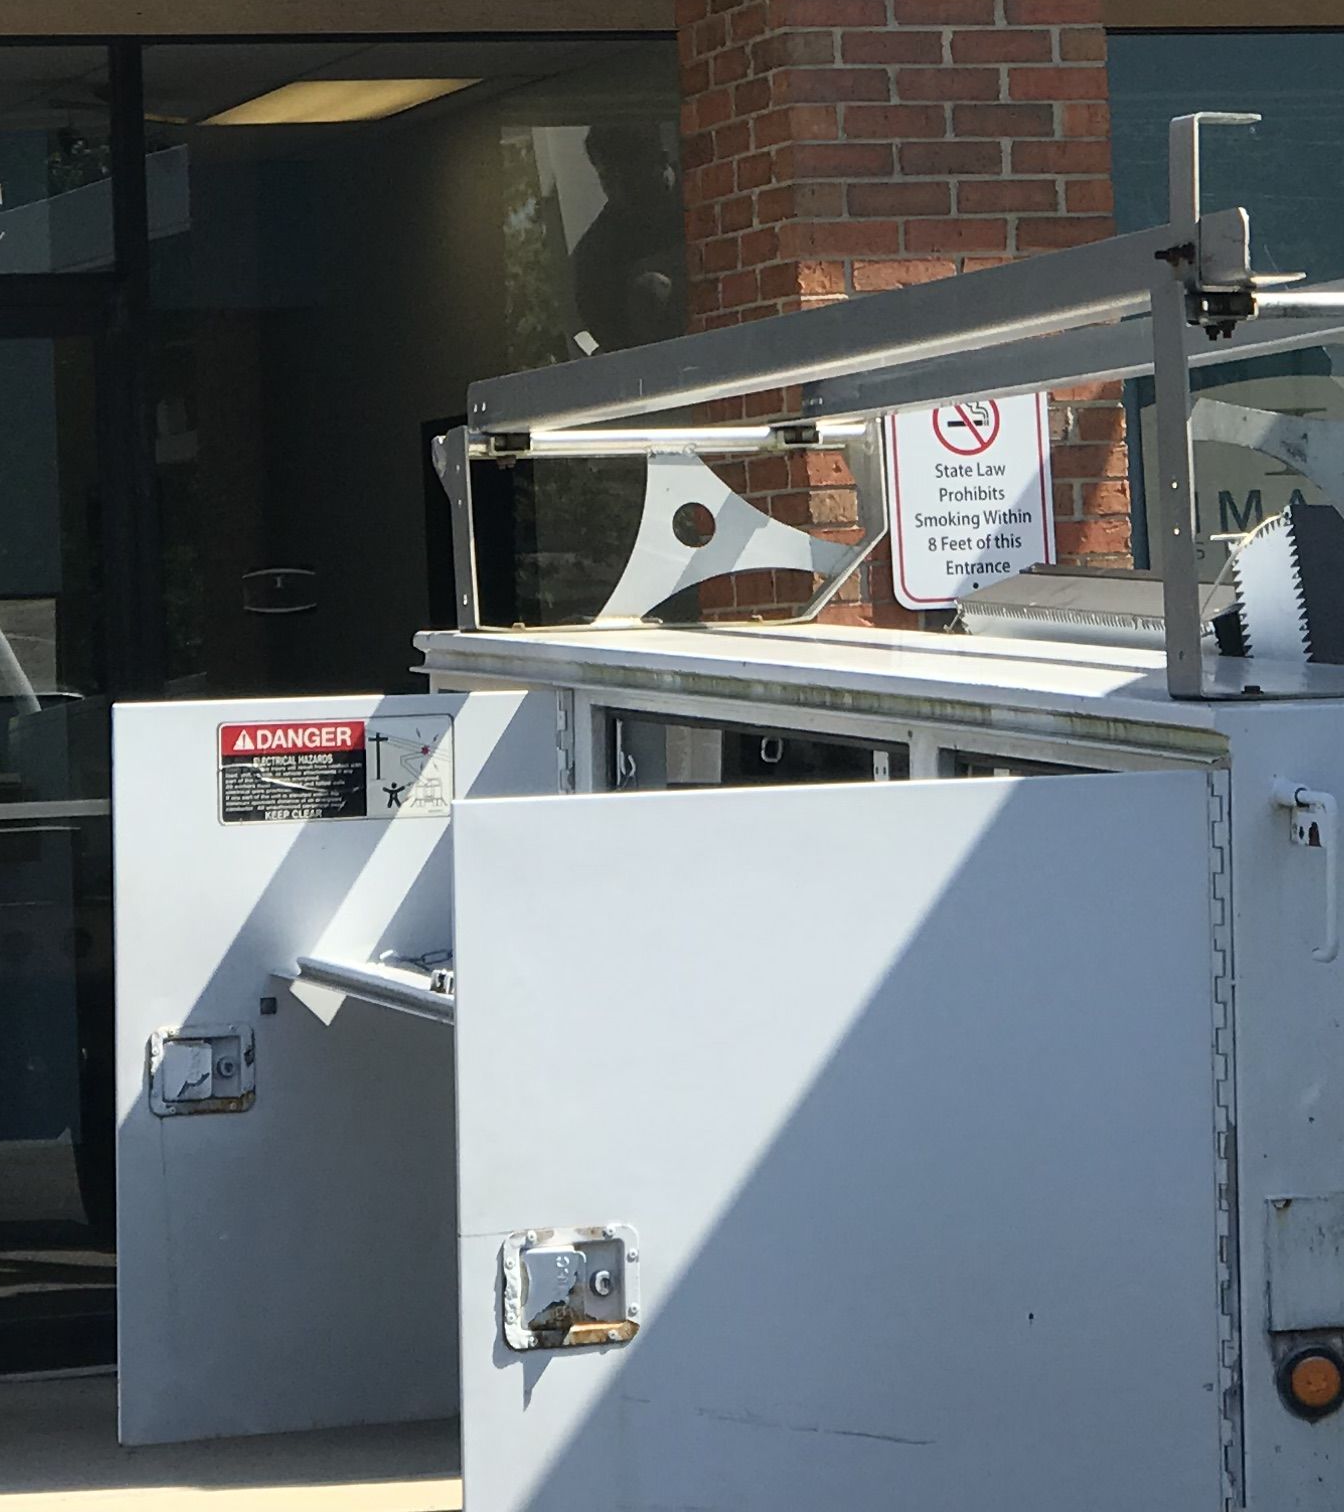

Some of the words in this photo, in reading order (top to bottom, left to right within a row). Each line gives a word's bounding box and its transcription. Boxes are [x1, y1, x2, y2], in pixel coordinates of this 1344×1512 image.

[935, 463, 973, 478] State
[977, 462, 1006, 477] Law
[939, 485, 1005, 502] Prohibits
[914, 511, 981, 530] Smoking
[983, 508, 1033, 526] Within
[927, 537, 938, 552] 8
[941, 536, 973, 551] Feet
[976, 534, 993, 550] of
[994, 533, 1022, 549] this
[946, 560, 1011, 576] Entrance
[256, 726, 353, 750] DANGER
[297, 753, 334, 765] HAZARDS
[264, 810, 290, 820] KEEP
[291, 809, 323, 819] CLEAR
